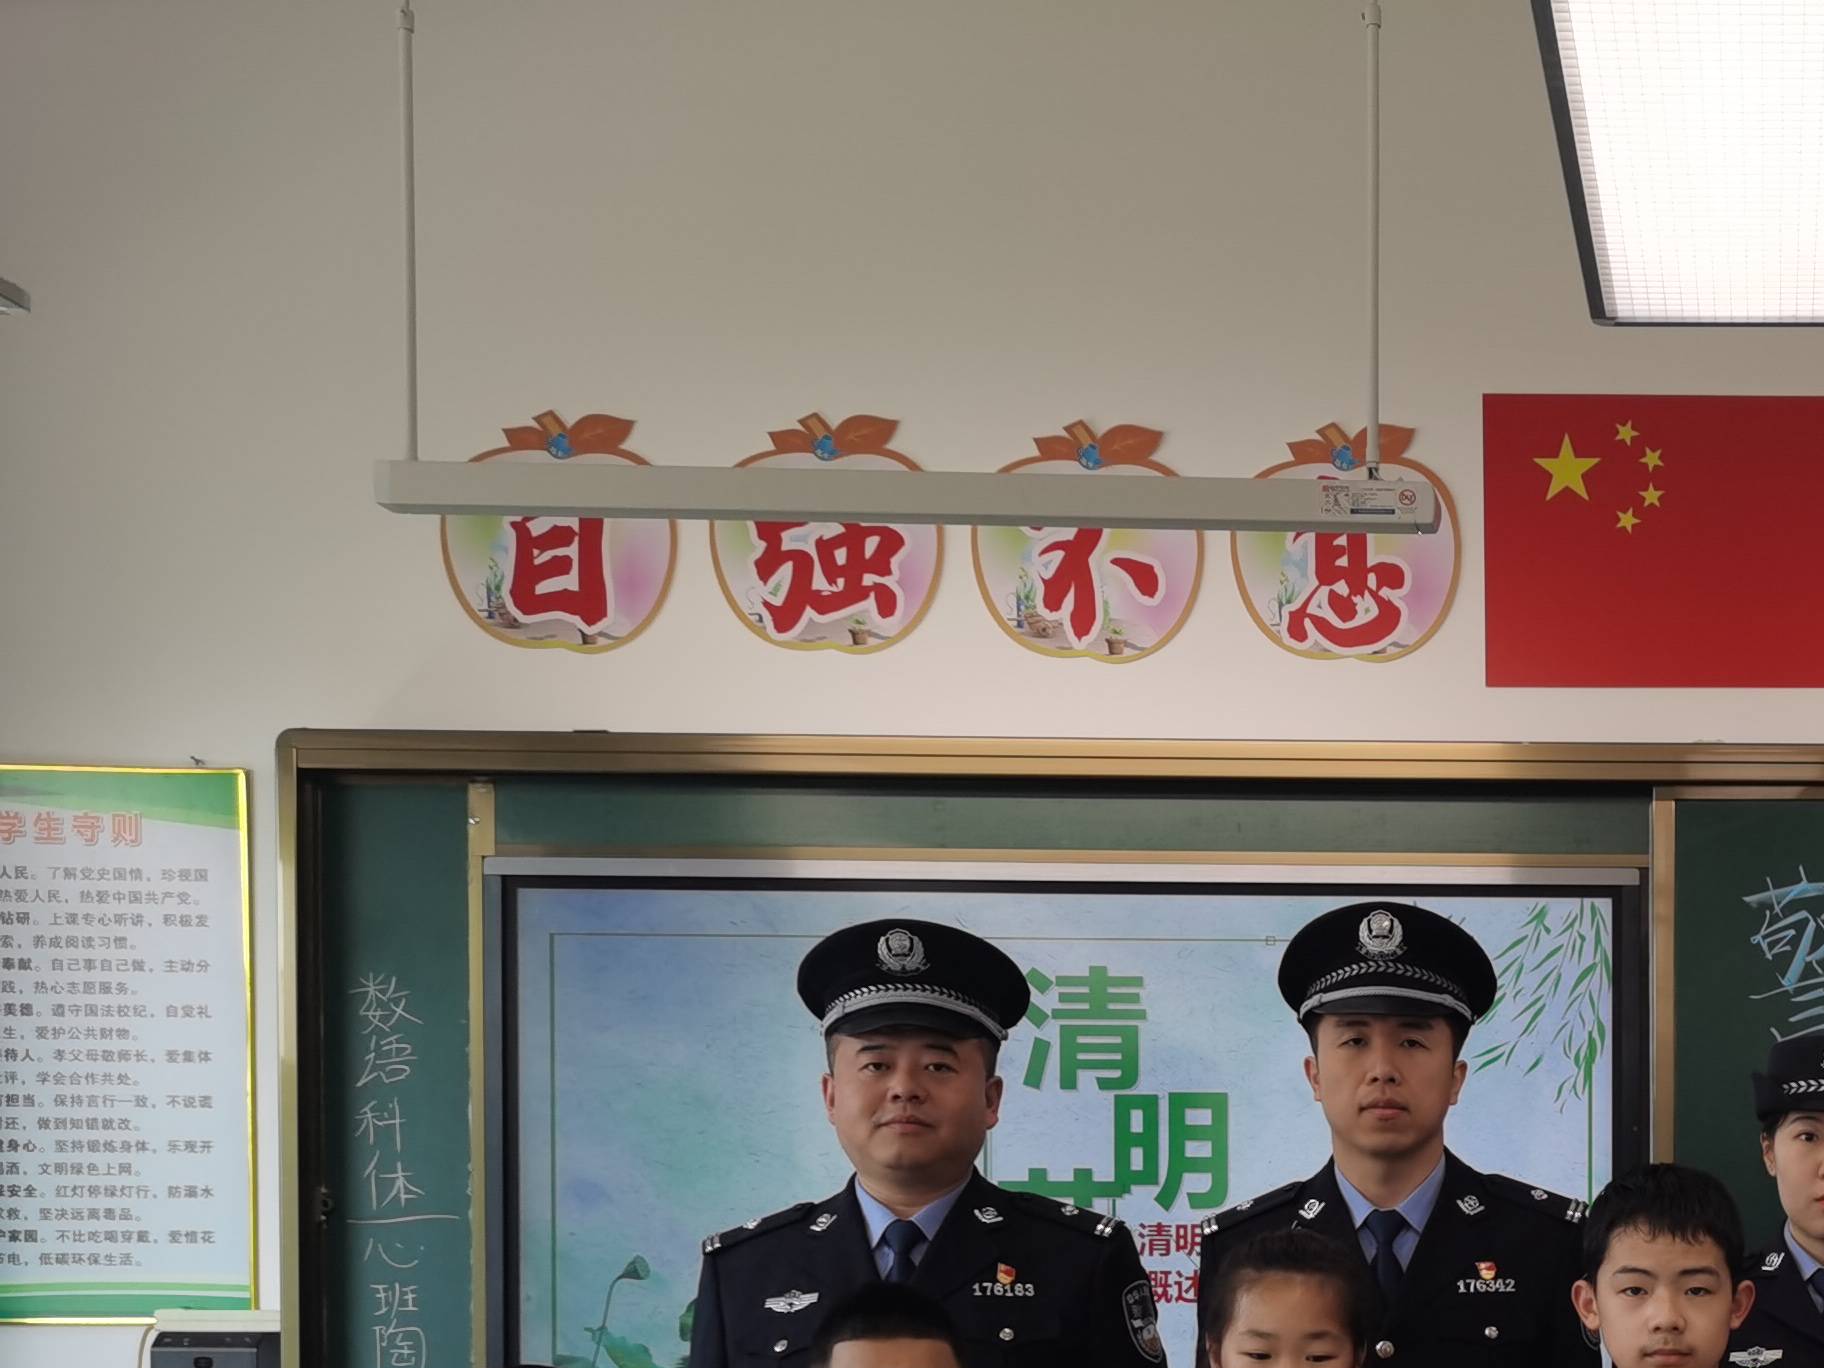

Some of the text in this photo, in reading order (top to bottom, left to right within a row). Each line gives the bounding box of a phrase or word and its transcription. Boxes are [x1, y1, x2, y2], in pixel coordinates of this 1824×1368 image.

[0, 1003, 212, 1019] 美德。遵守国法校纪，自觉礼
[0, 1048, 213, 1064] 待人。孝父母敬师长，爱集体
[0, 1071, 140, 1086] 评，学会合作共处。
[0, 1117, 141, 1132] 还，做到知错就改。
[972, 1282, 1036, 1297] 176183
[1456, 1278, 1516, 1293] 176342
